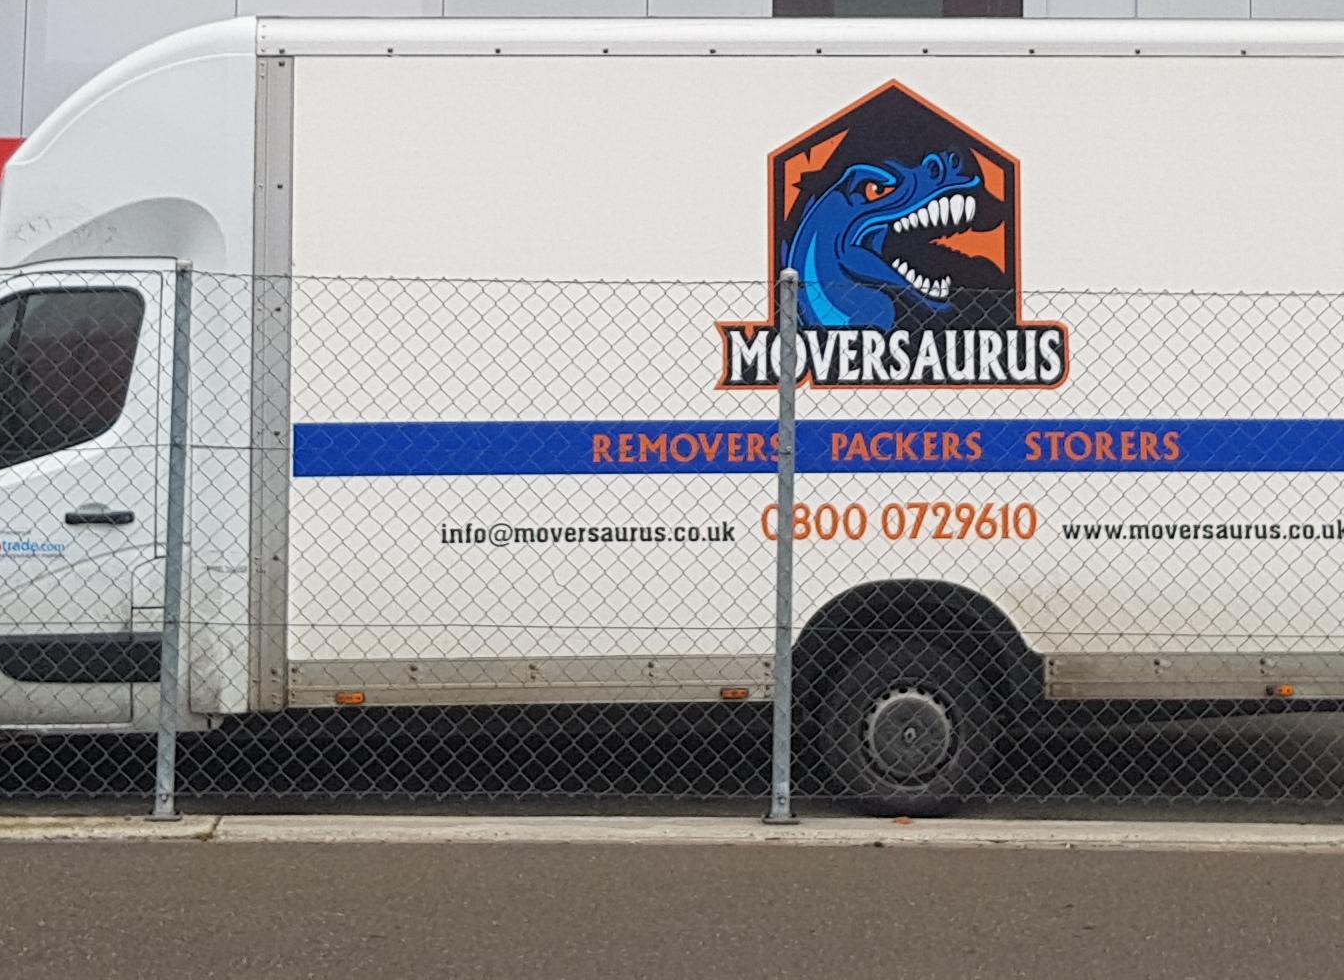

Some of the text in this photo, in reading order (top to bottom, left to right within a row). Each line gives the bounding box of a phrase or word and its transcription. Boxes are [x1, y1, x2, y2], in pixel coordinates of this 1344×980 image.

[729, 328, 1062, 382] MOVERSAURUS
[830, 432, 983, 462] PACKERS
[1025, 431, 1180, 461] STORERS
[441, 521, 736, 546] info@moversaurus.co.uk
[760, 502, 868, 541] 0800
[881, 502, 1037, 540] 0729610
